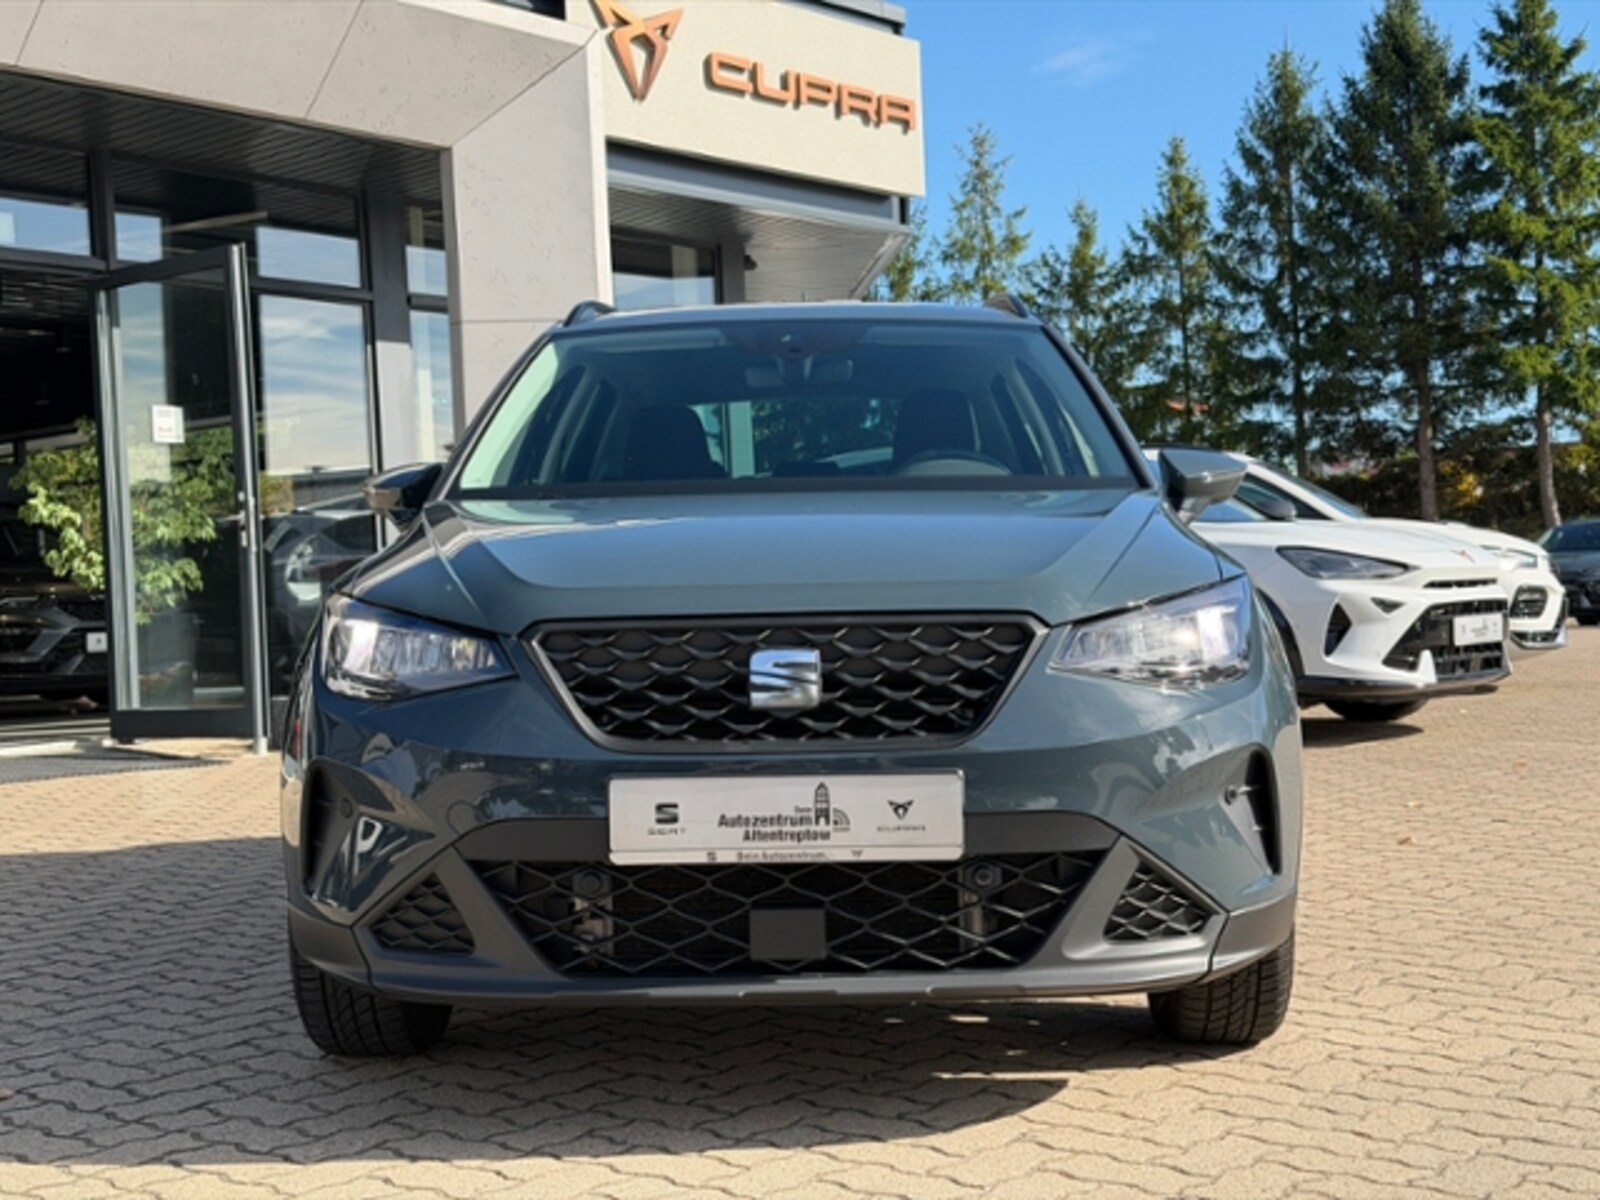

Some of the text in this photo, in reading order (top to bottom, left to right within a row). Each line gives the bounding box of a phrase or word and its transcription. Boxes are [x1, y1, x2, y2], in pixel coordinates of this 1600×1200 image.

[705, 52, 917, 132] CUPRA
[718, 814, 813, 827] Autozentrum
[743, 829, 831, 843] Altentreptow
